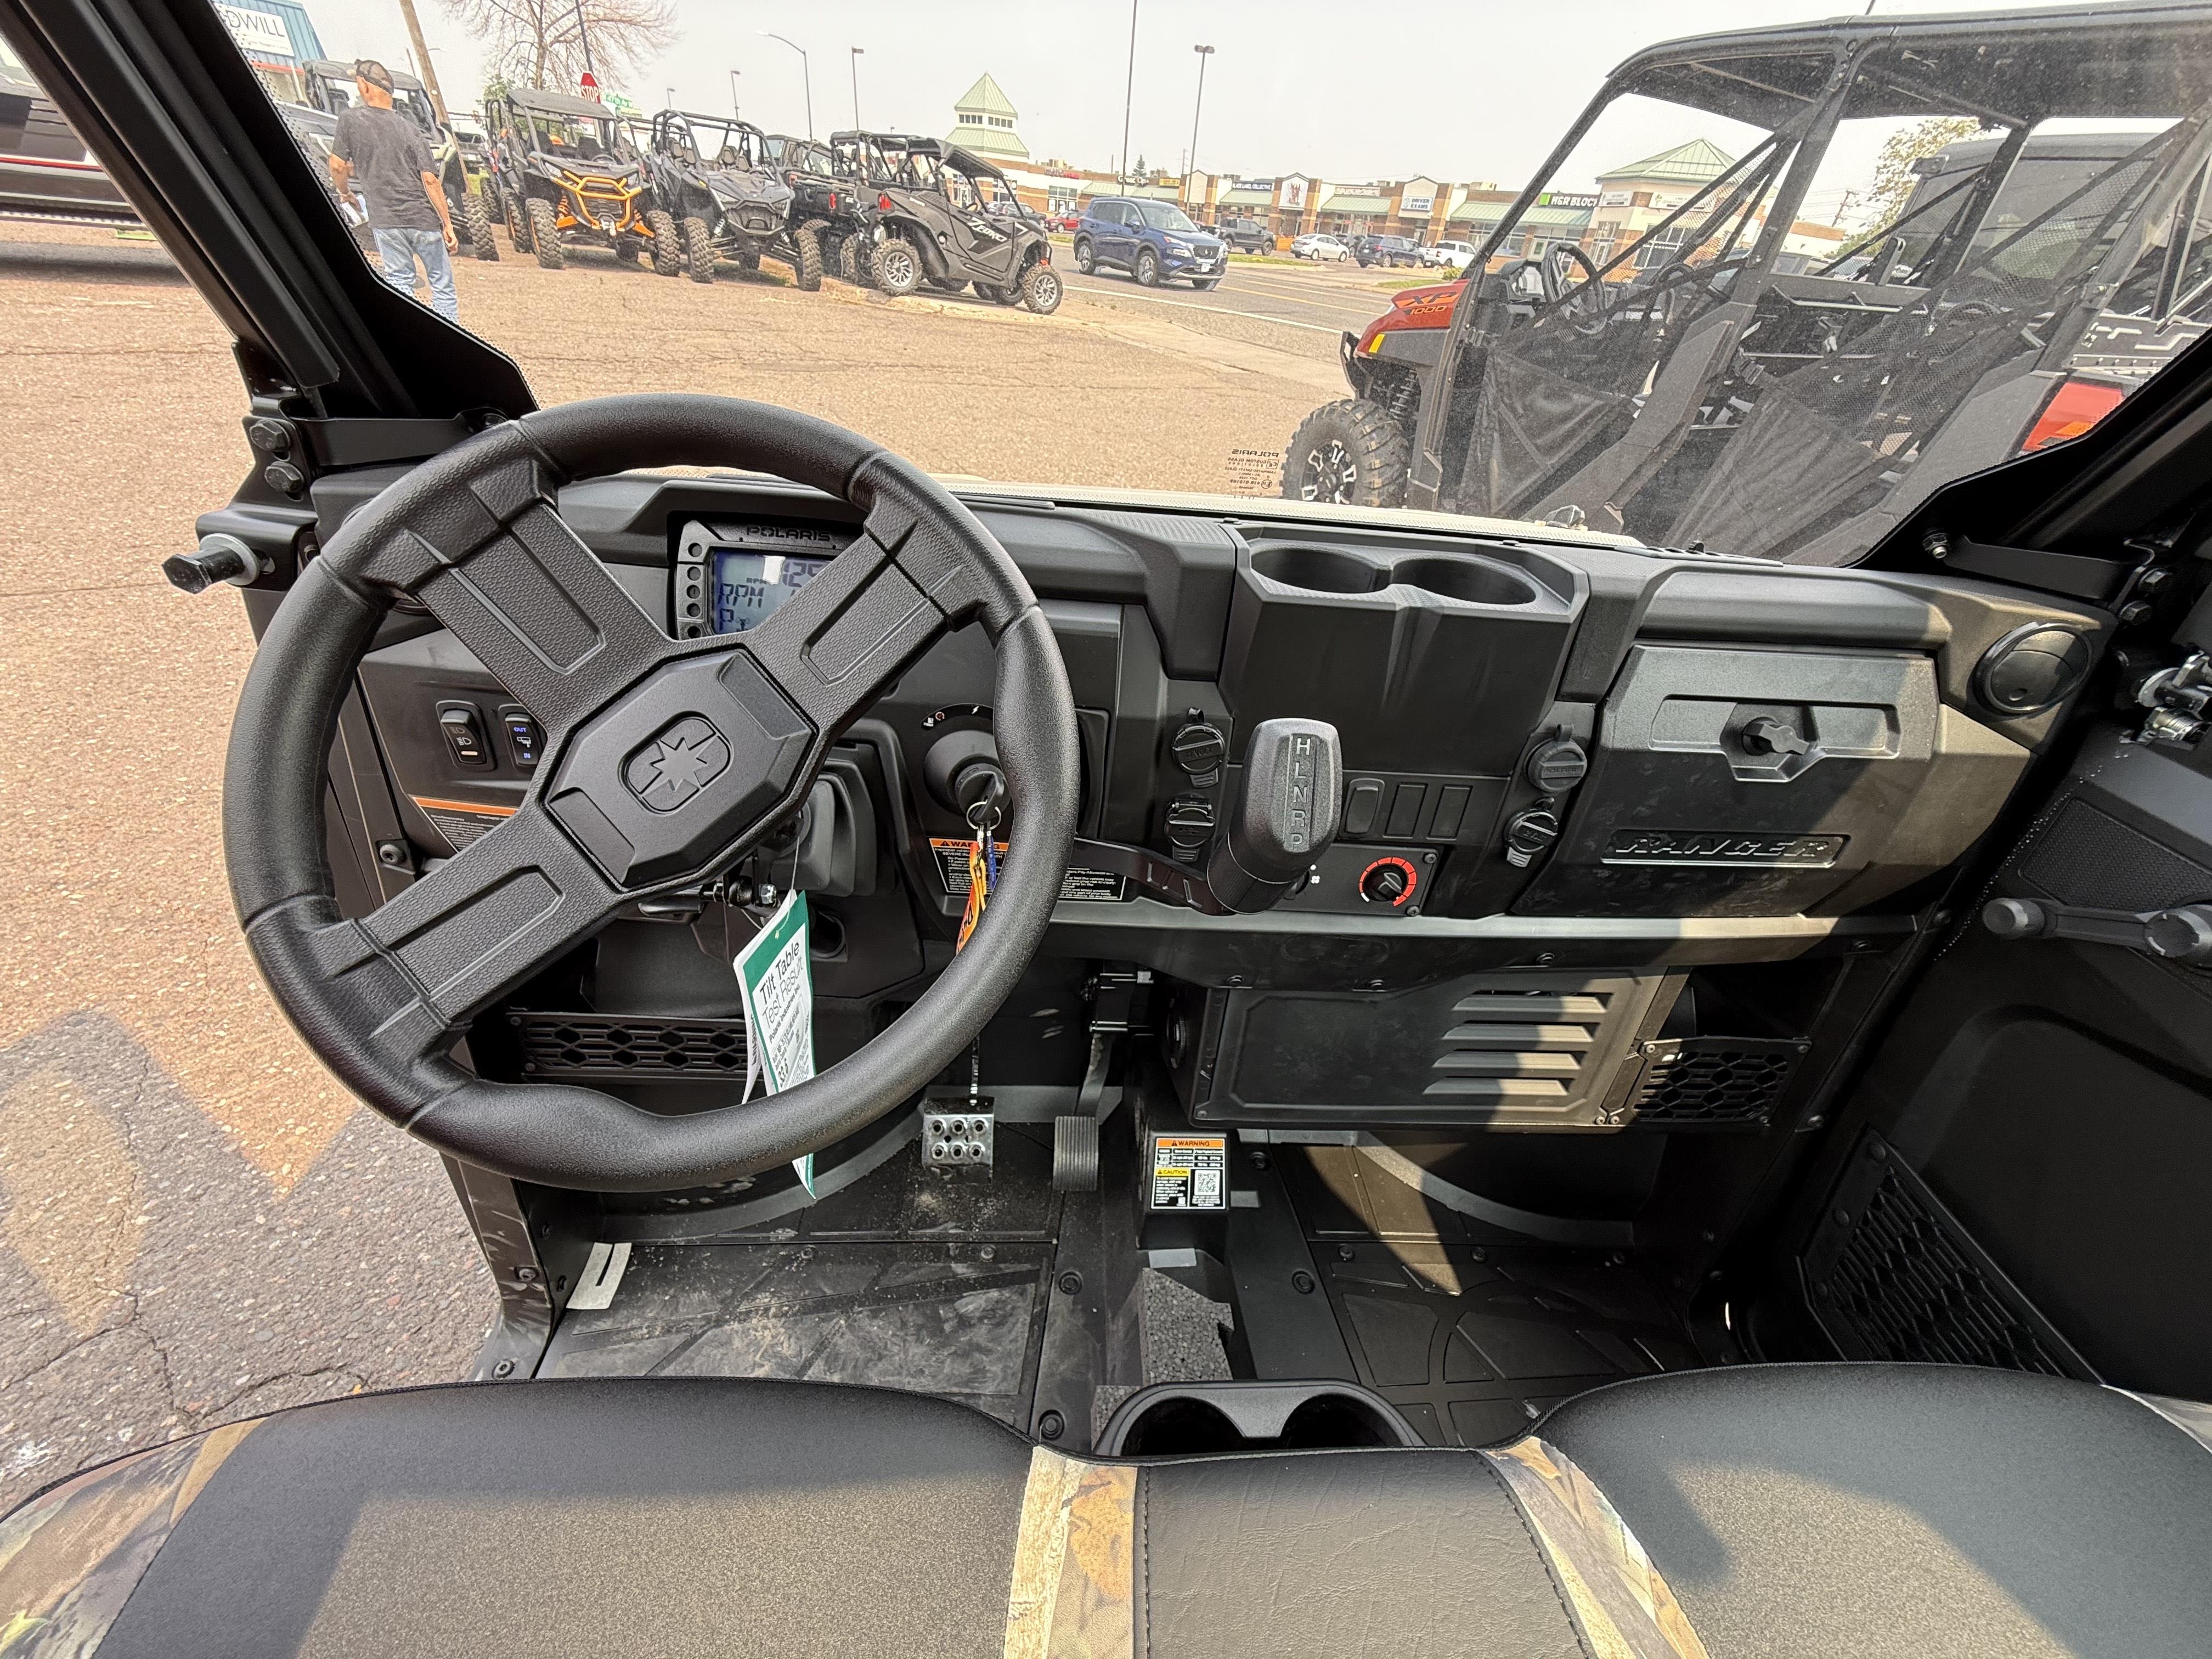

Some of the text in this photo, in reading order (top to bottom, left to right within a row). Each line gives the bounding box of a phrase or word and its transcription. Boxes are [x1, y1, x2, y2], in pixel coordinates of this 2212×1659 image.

[221, 10, 285, 37] DWILL
[581, 85, 600, 103] STOP
[1551, 196, 1571, 206] H&R
[1403, 291, 1457, 307] XP
[1410, 305, 1448, 315] 1000
[747, 526, 831, 541] POLARIS
[1296, 737, 1311, 755] H
[1294, 761, 1307, 779] L
[1293, 786, 1308, 803] N
[1290, 809, 1306, 827] R
[951, 841, 1000, 849] WARG
[1290, 833, 1304, 850] P
[760, 942, 799, 1005] Tilt Table
[762, 992, 782, 1028] Test
[780, 955, 803, 1002] Result
